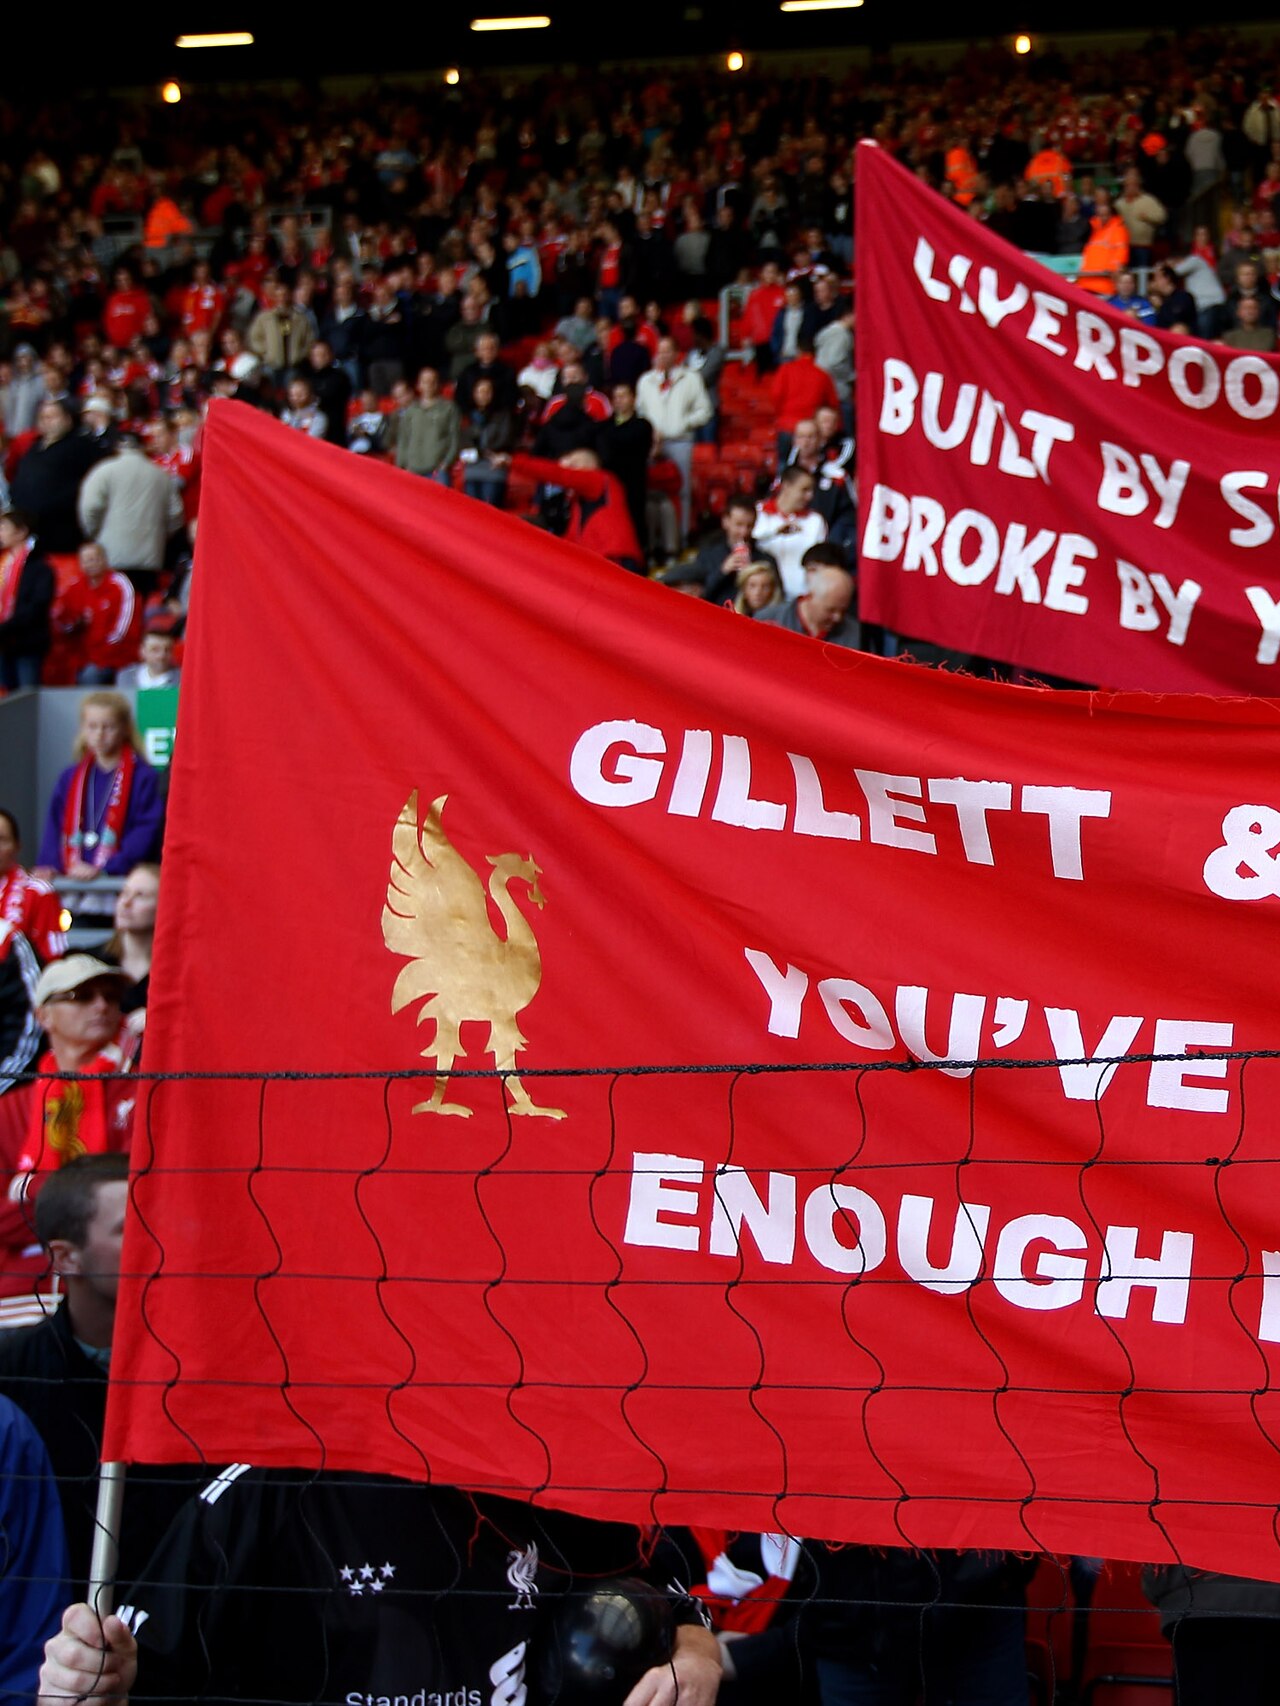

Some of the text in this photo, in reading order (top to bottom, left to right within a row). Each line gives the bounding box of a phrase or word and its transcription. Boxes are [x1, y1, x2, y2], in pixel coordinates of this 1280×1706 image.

[879, 357, 1076, 484] BUILT
[1097, 441, 1191, 530] BY
[862, 483, 1098, 616] BROKE
[1117, 559, 1203, 646] BY
[571, 719, 1112, 882] GILLETT
[743, 947, 1235, 1114] YOU'VE
[624, 1151, 1194, 1325] ENOUGH
